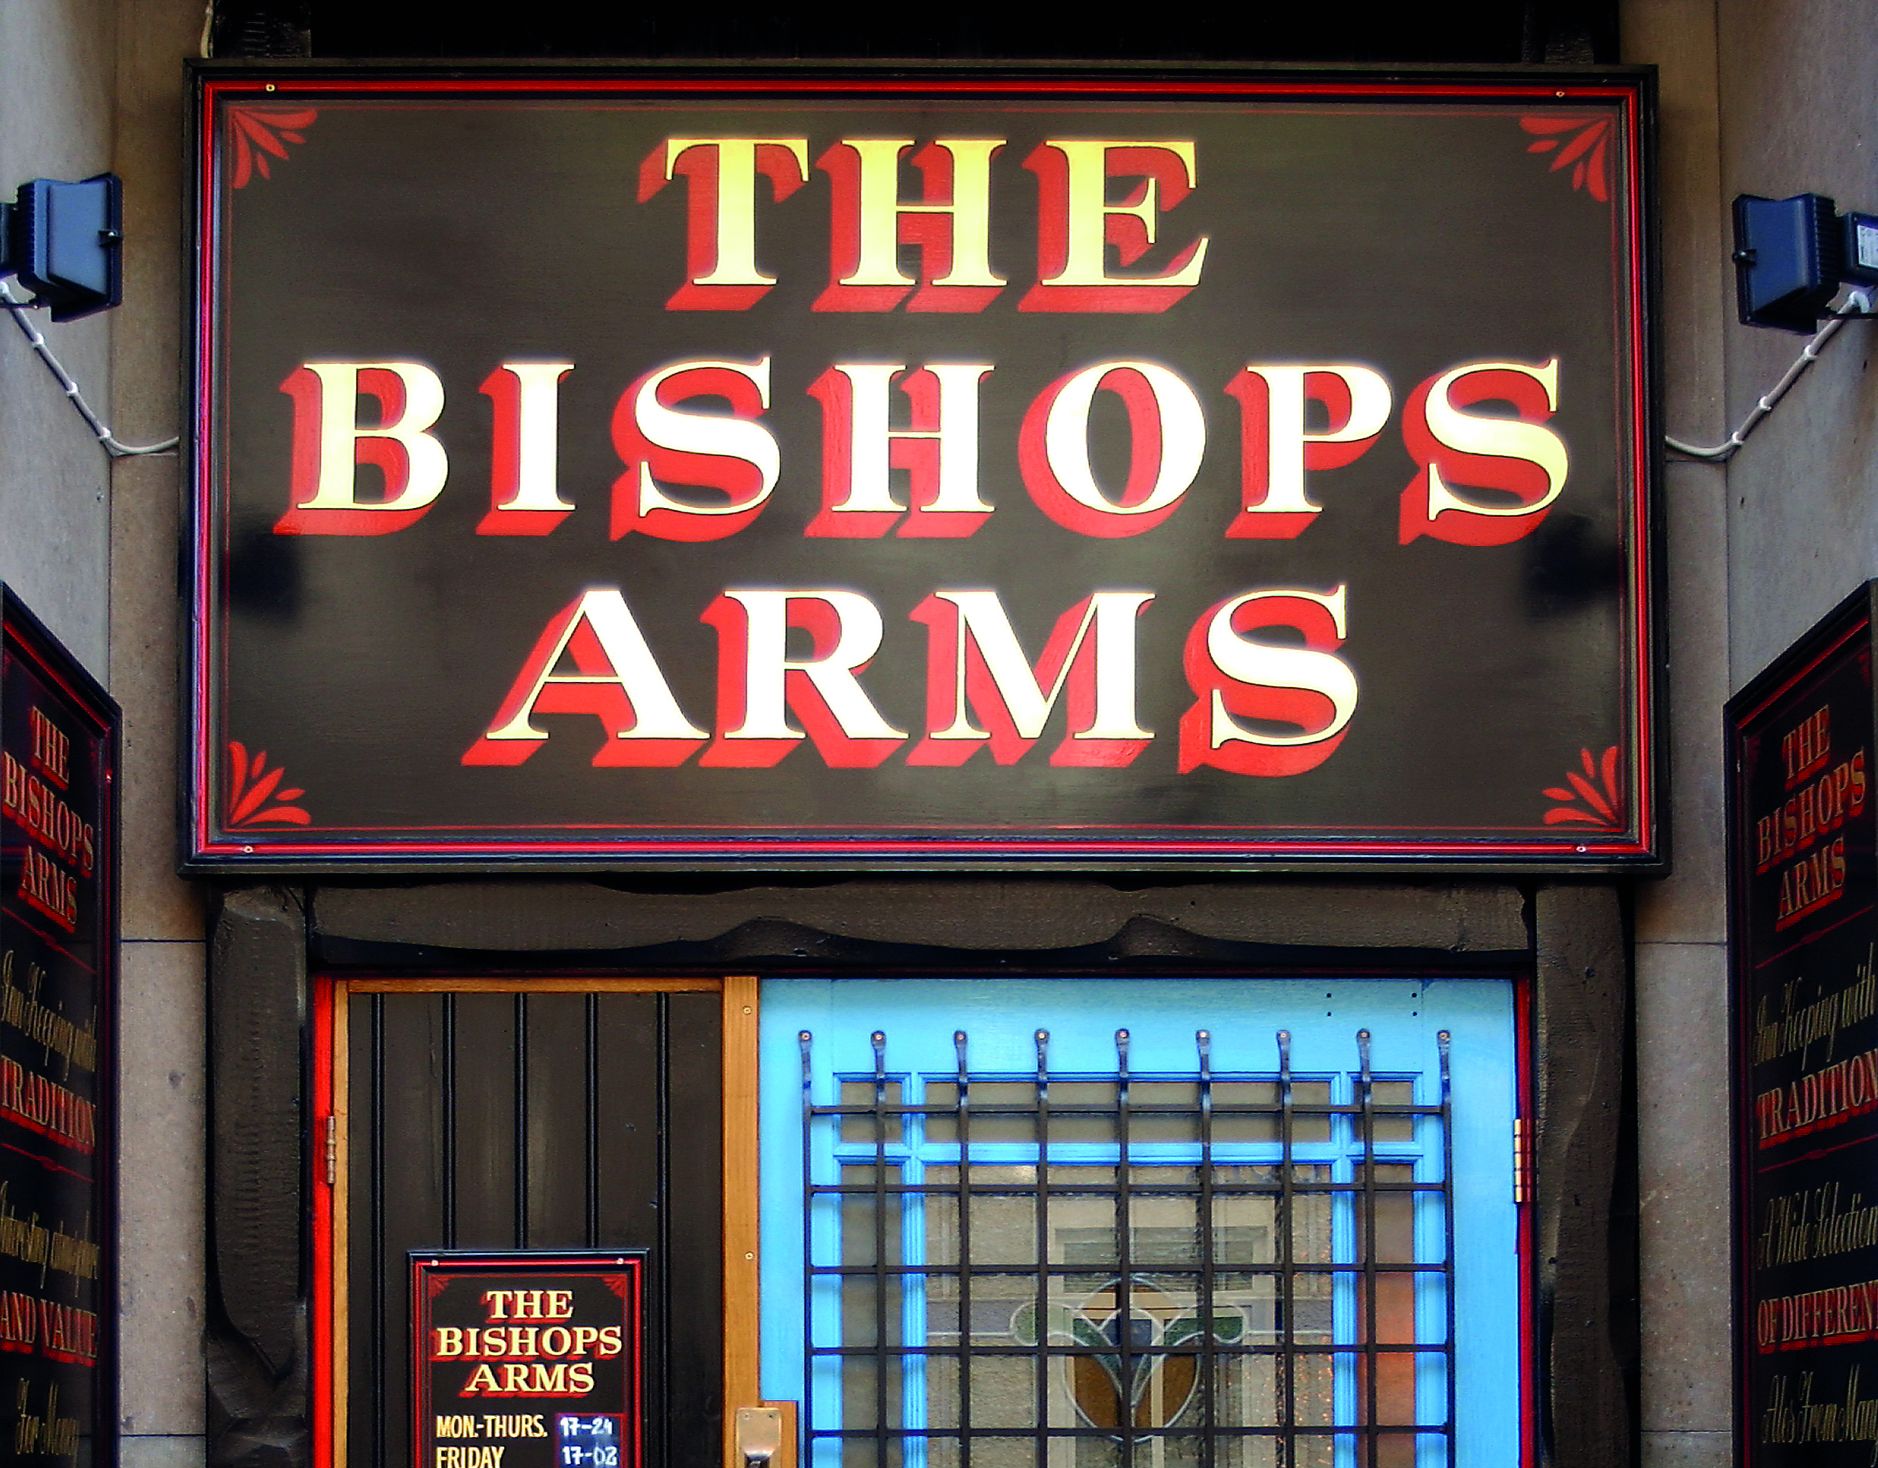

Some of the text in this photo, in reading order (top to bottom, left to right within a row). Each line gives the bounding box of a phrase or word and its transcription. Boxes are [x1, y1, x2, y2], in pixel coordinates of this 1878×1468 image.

[638, 136, 1211, 312] THE
[275, 355, 1570, 546] BISHOPS
[461, 583, 1361, 776] ARMS
[31, 704, 71, 788] THE
[1782, 704, 1831, 782] THE
[2, 750, 96, 873] BISHOPS
[1756, 747, 1867, 866] BISHOPS
[19, 844, 79, 925] ARMS
[1777, 836, 1847, 921] ARMS
[1780, 976, 1840, 1071] Keeping
[1839, 941, 1877, 1028] with
[1757, 1047, 1878, 1140] TRADITION
[1775, 1190, 1810, 1266] Wide
[1811, 1181, 1878, 1259] Selection
[435, 1326, 623, 1358] BISHOPS
[484, 1290, 574, 1320] THE
[1757, 1298, 1780, 1347] OF
[463, 1362, 596, 1395] ARMS
[1838, 1364, 1878, 1468] Many
[560, 1416, 613, 1437] 17-24
[562, 1445, 618, 1467] 17-02
